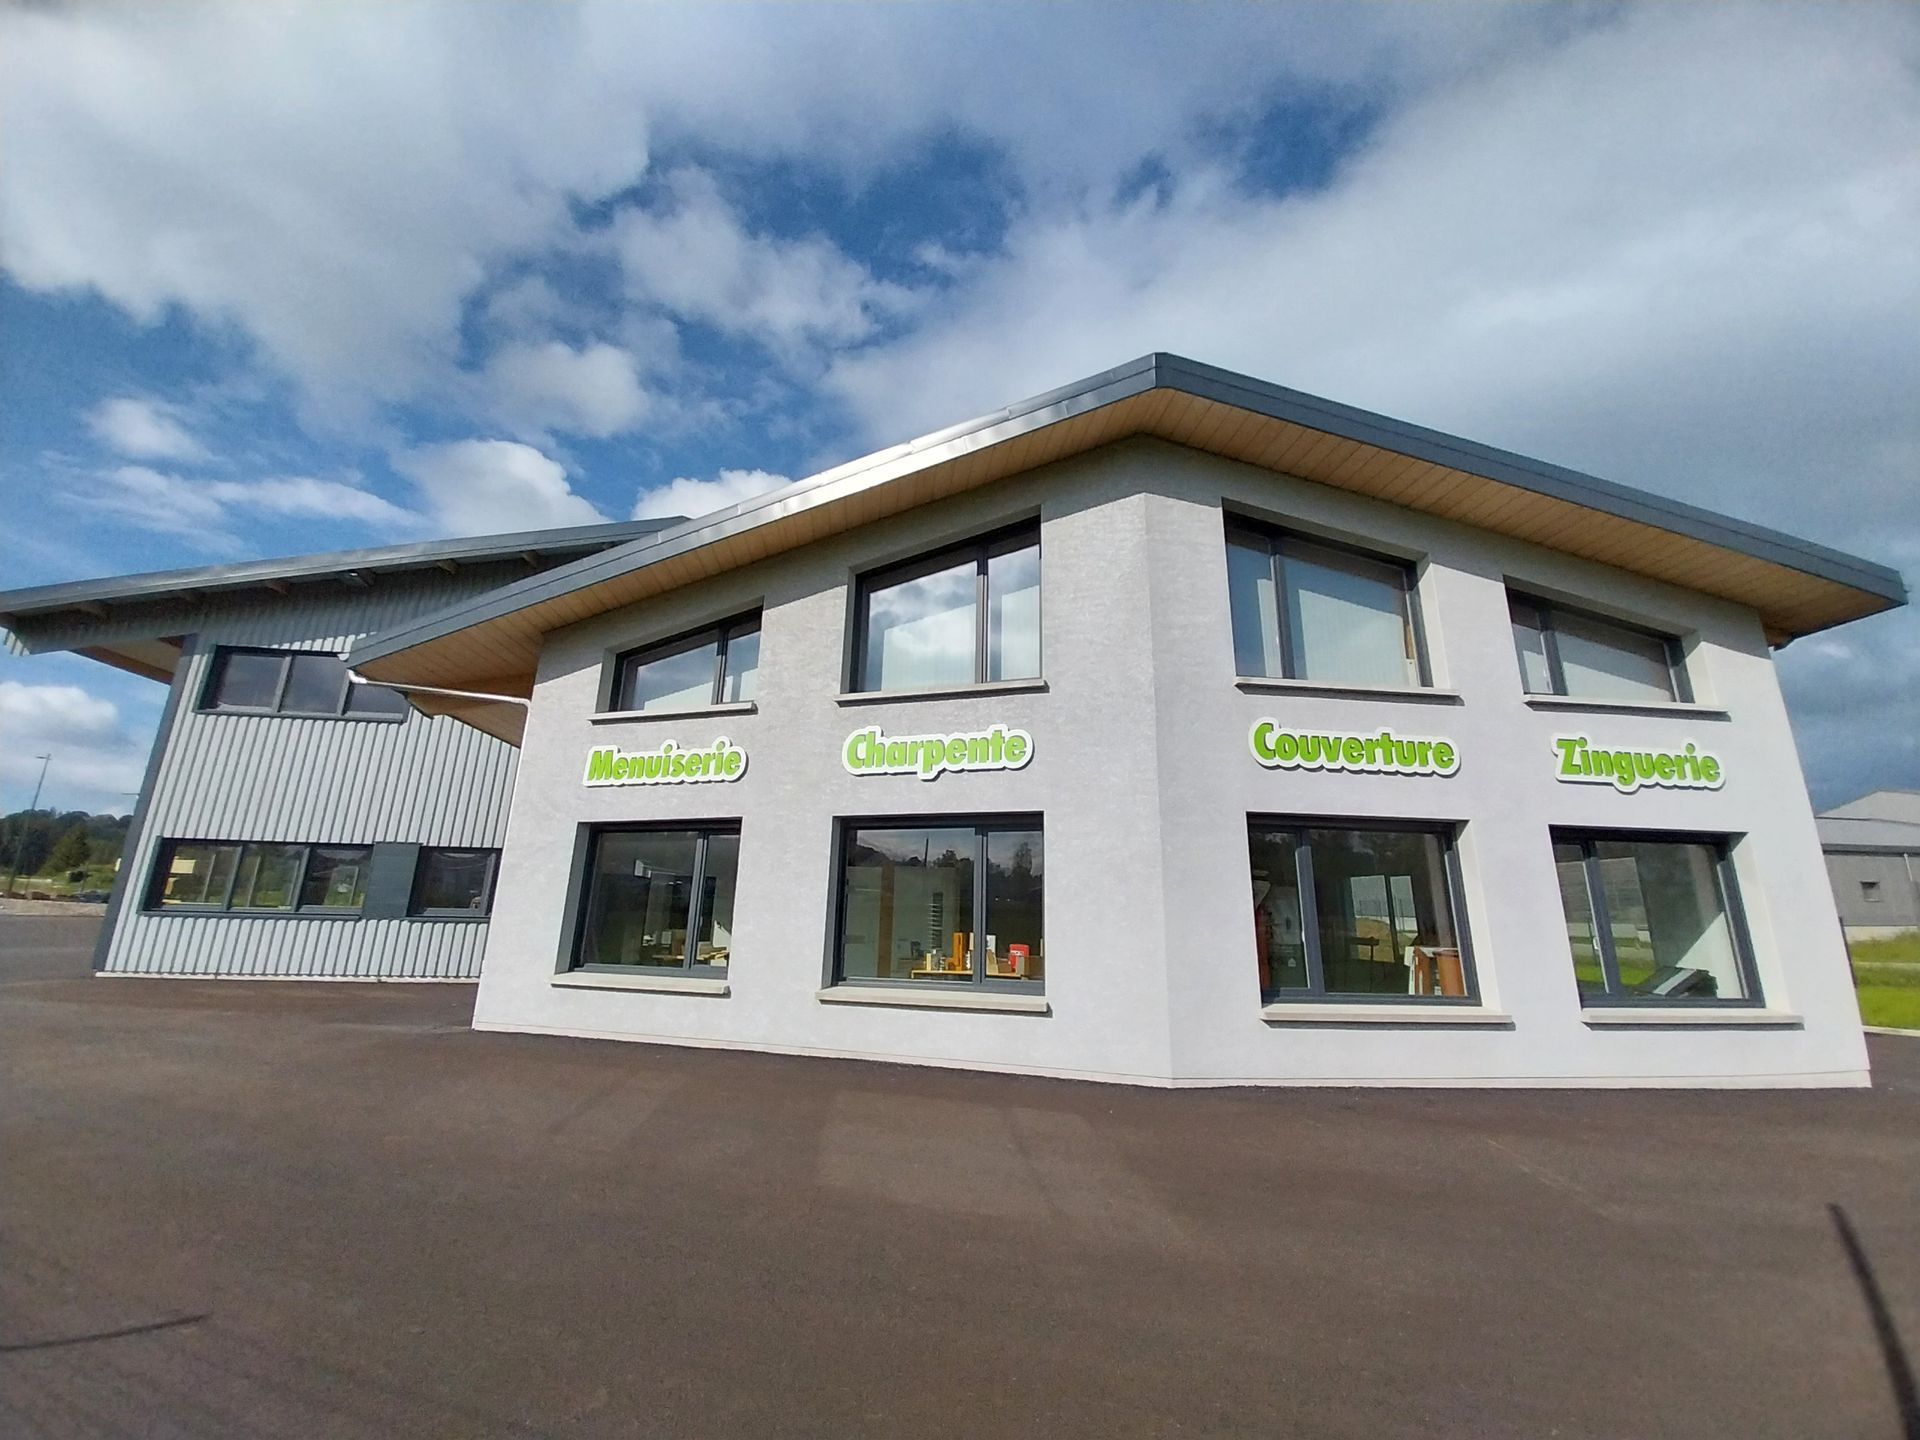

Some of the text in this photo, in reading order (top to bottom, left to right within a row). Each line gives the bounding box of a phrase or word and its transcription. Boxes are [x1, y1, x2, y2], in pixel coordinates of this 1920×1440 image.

[587, 738, 742, 782] Menuiserie
[846, 731, 1027, 773] Charpente
[1252, 722, 1455, 770] Couverture
[1555, 737, 1720, 786] Zinguerie
